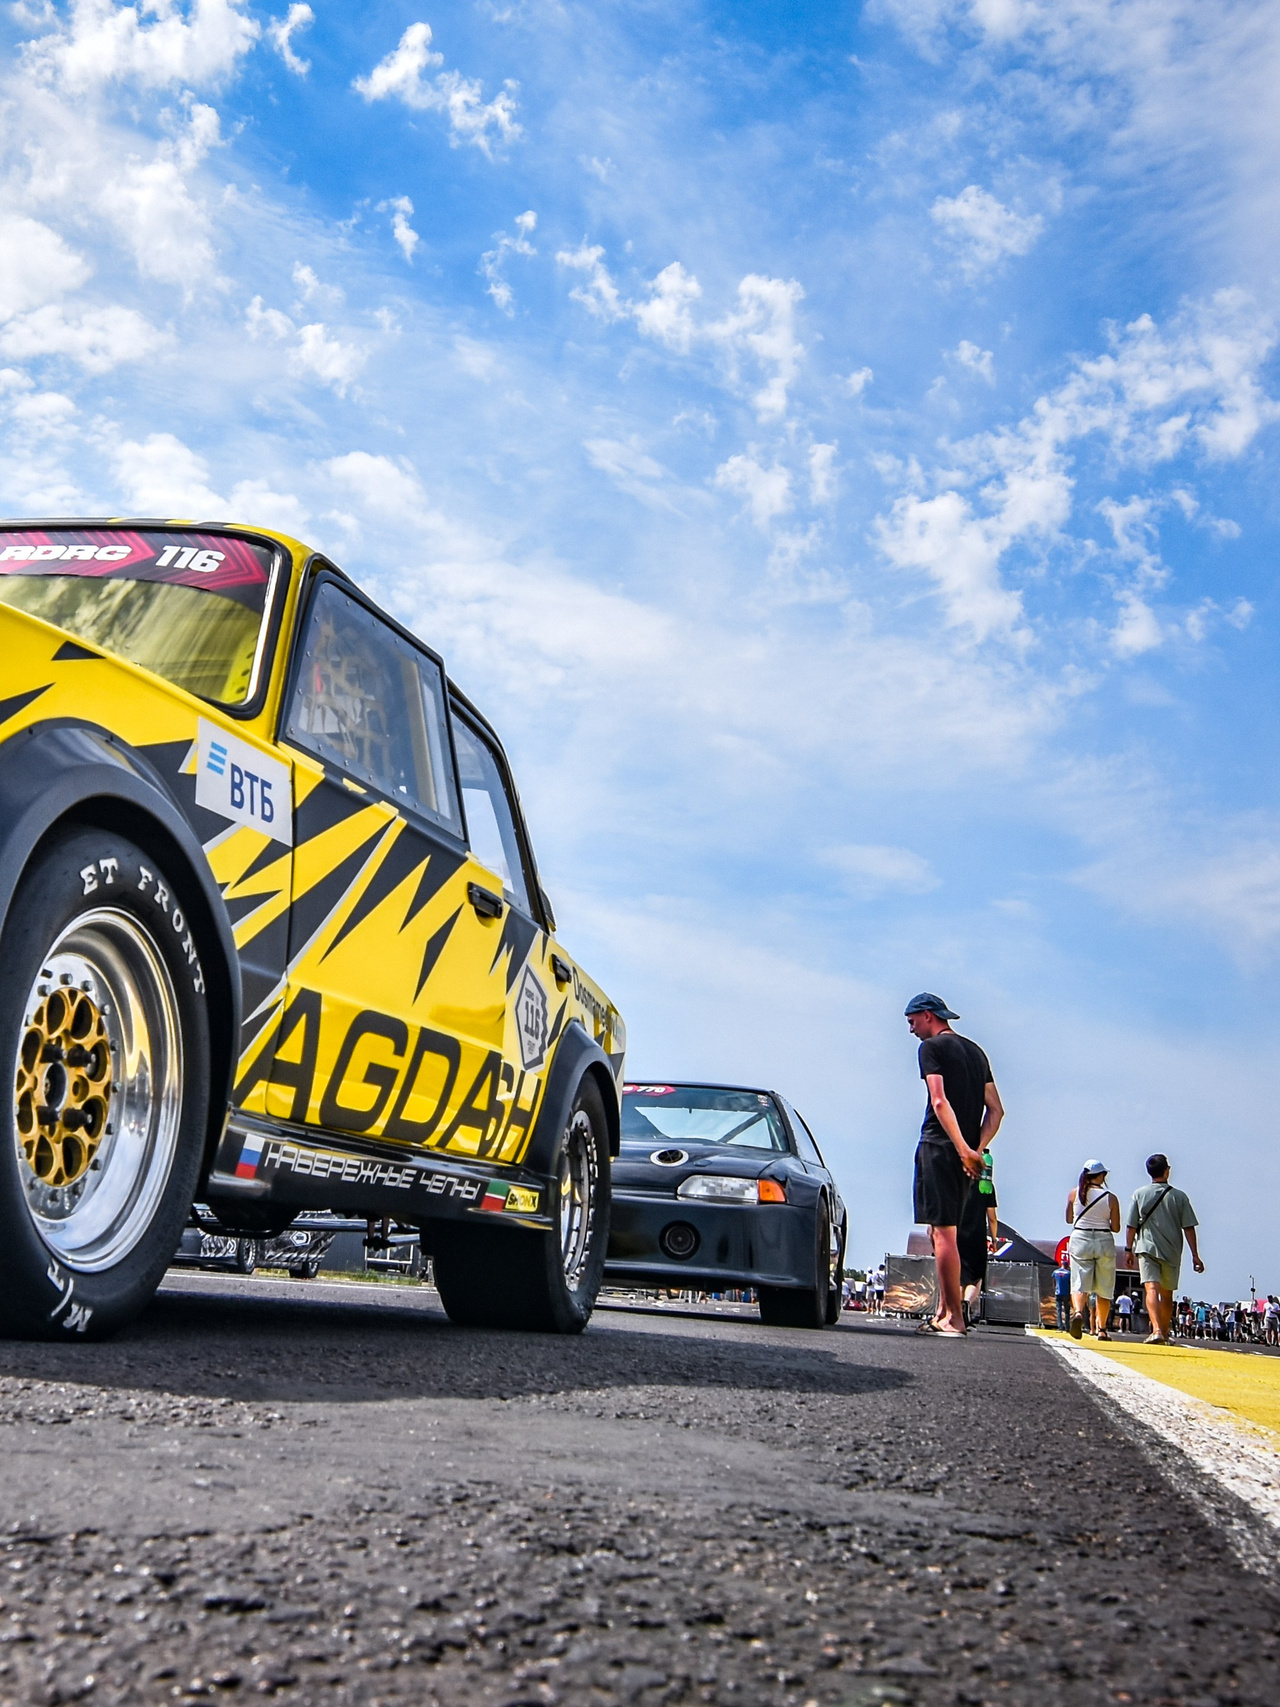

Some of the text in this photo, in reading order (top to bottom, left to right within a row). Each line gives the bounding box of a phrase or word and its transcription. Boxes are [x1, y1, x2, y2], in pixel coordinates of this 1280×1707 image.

[155, 545, 226, 573] 116
[230, 762, 274, 823] ВТБ
[80, 857, 206, 995] ET FRONT
[265, 1143, 481, 1200] НАБЕРЕЖНЫЕ ЧЕЛНЫ
